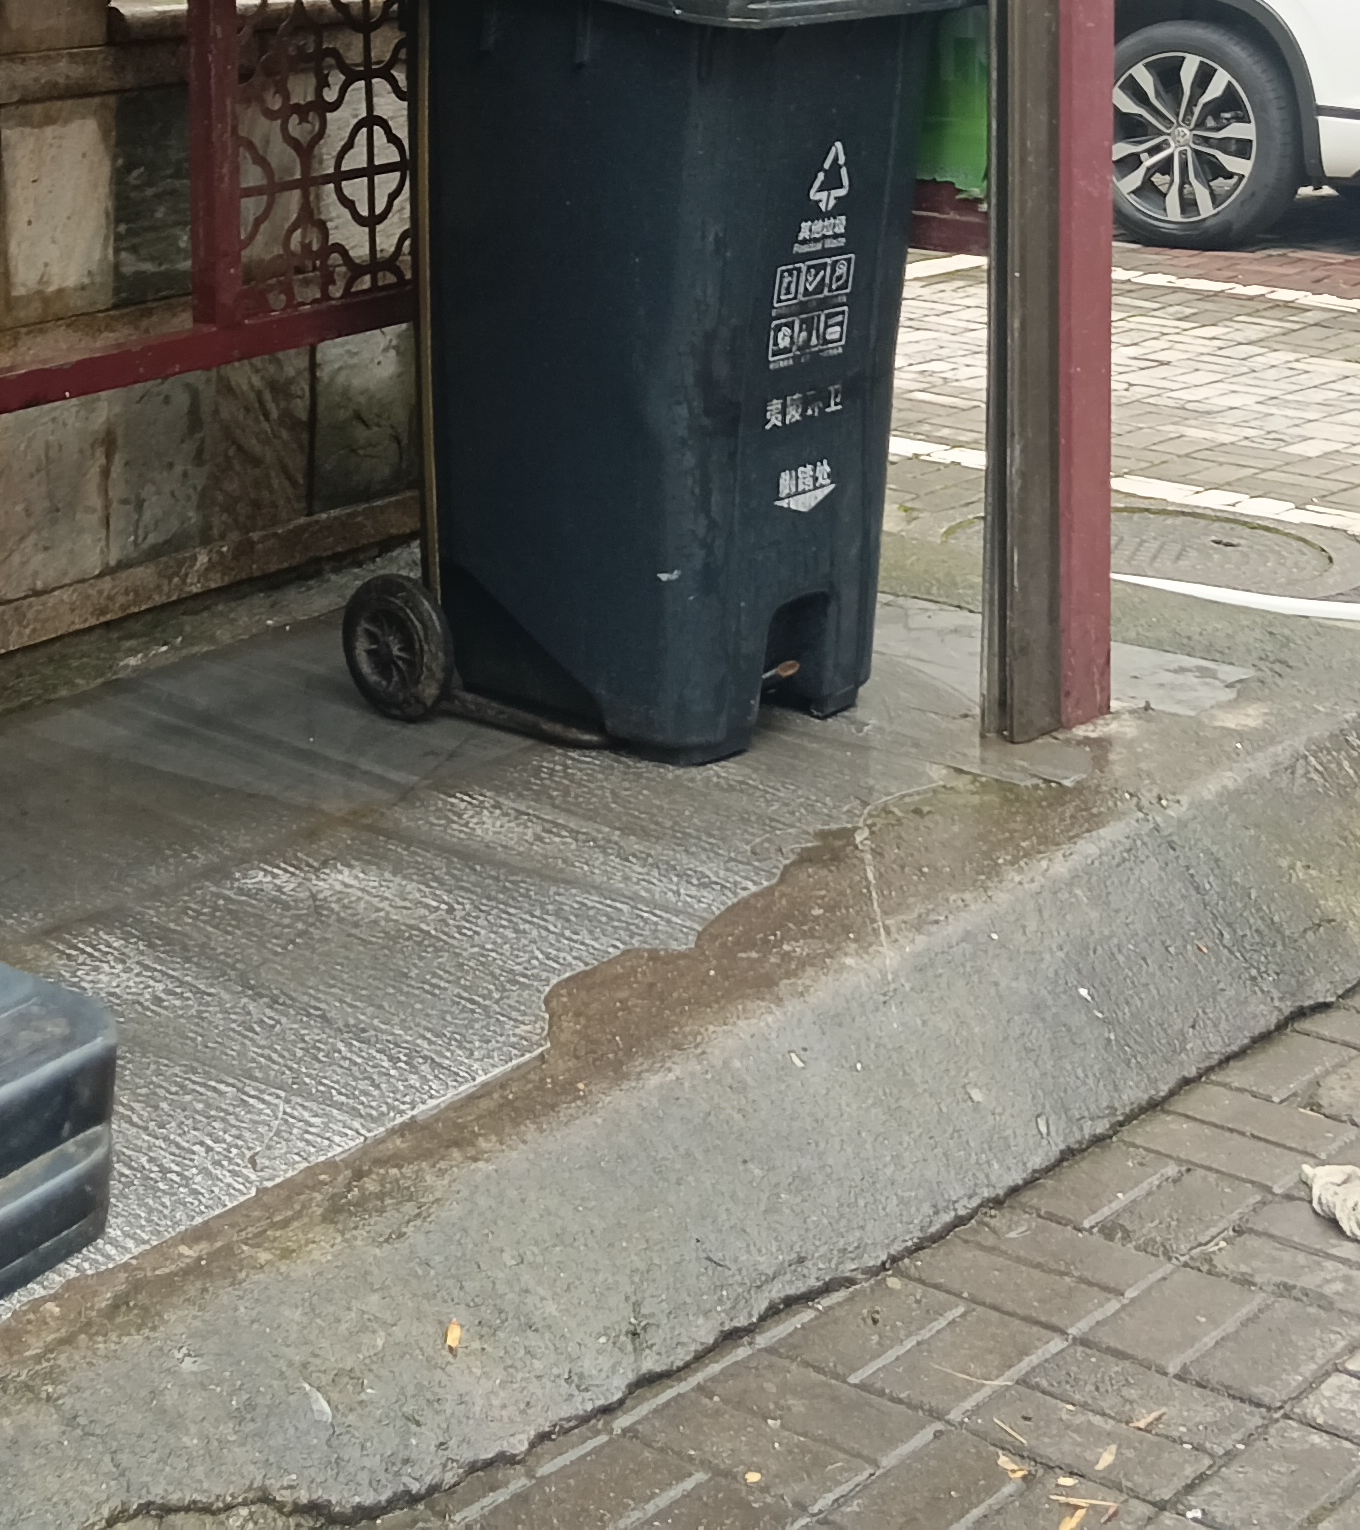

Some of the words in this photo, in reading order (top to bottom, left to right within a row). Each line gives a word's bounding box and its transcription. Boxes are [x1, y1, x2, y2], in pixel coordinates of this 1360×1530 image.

[797, 215, 846, 240] 其他垃圾
[778, 458, 831, 498] 脚踏处
